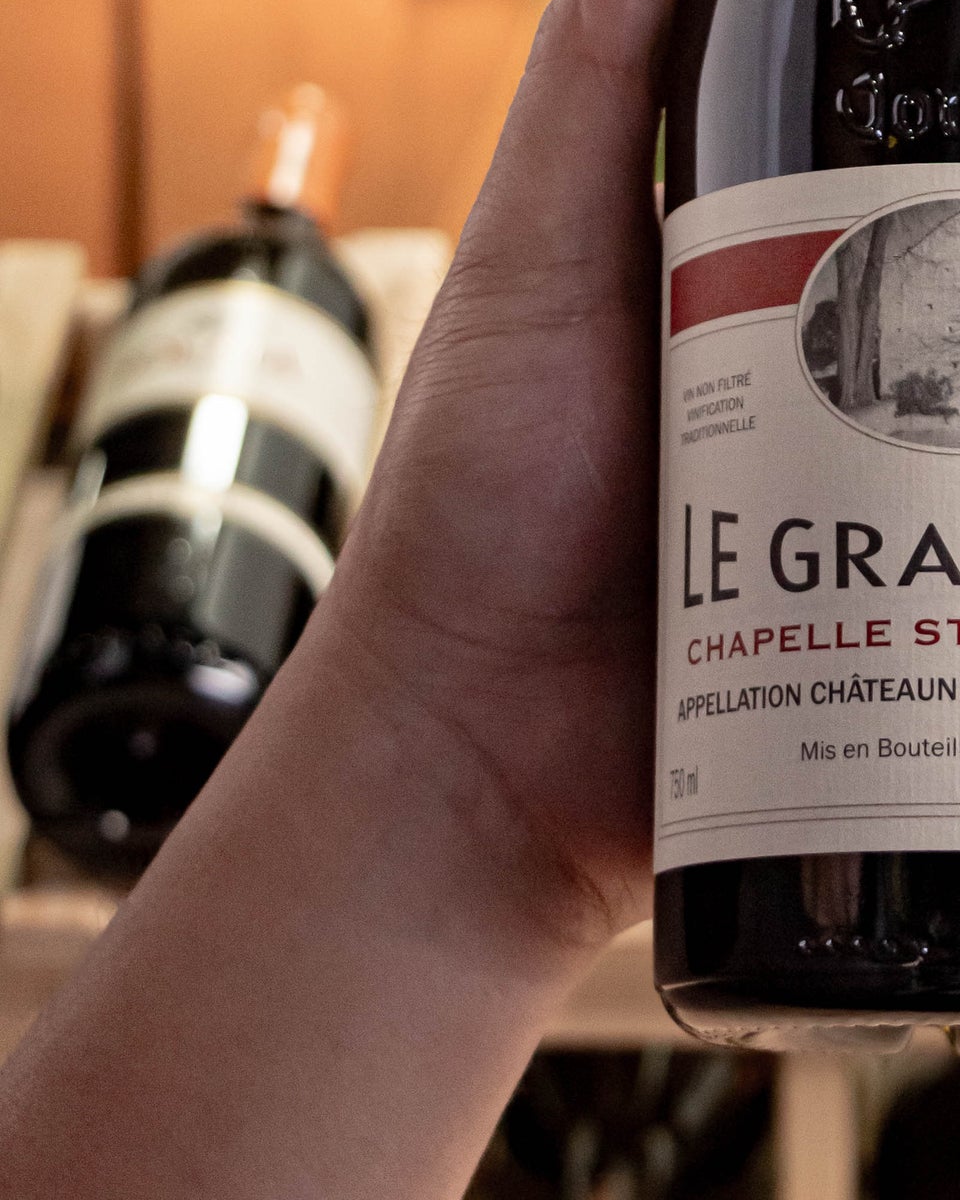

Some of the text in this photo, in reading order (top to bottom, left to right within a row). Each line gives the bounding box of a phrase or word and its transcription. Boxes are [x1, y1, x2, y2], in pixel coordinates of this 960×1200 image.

[696, 381, 716, 398] NON
[717, 368, 752, 392] FILTRÉ
[686, 395, 744, 422] VINIFICATION
[680, 415, 757, 446] TRADITIONNELLE
[683, 503, 740, 609] LE
[687, 618, 892, 666] CHAPELLE
[678, 682, 801, 723] APPELLATION
[801, 740, 837, 762] Mis
[842, 743, 869, 760] en
[670, 767, 685, 800] 750
